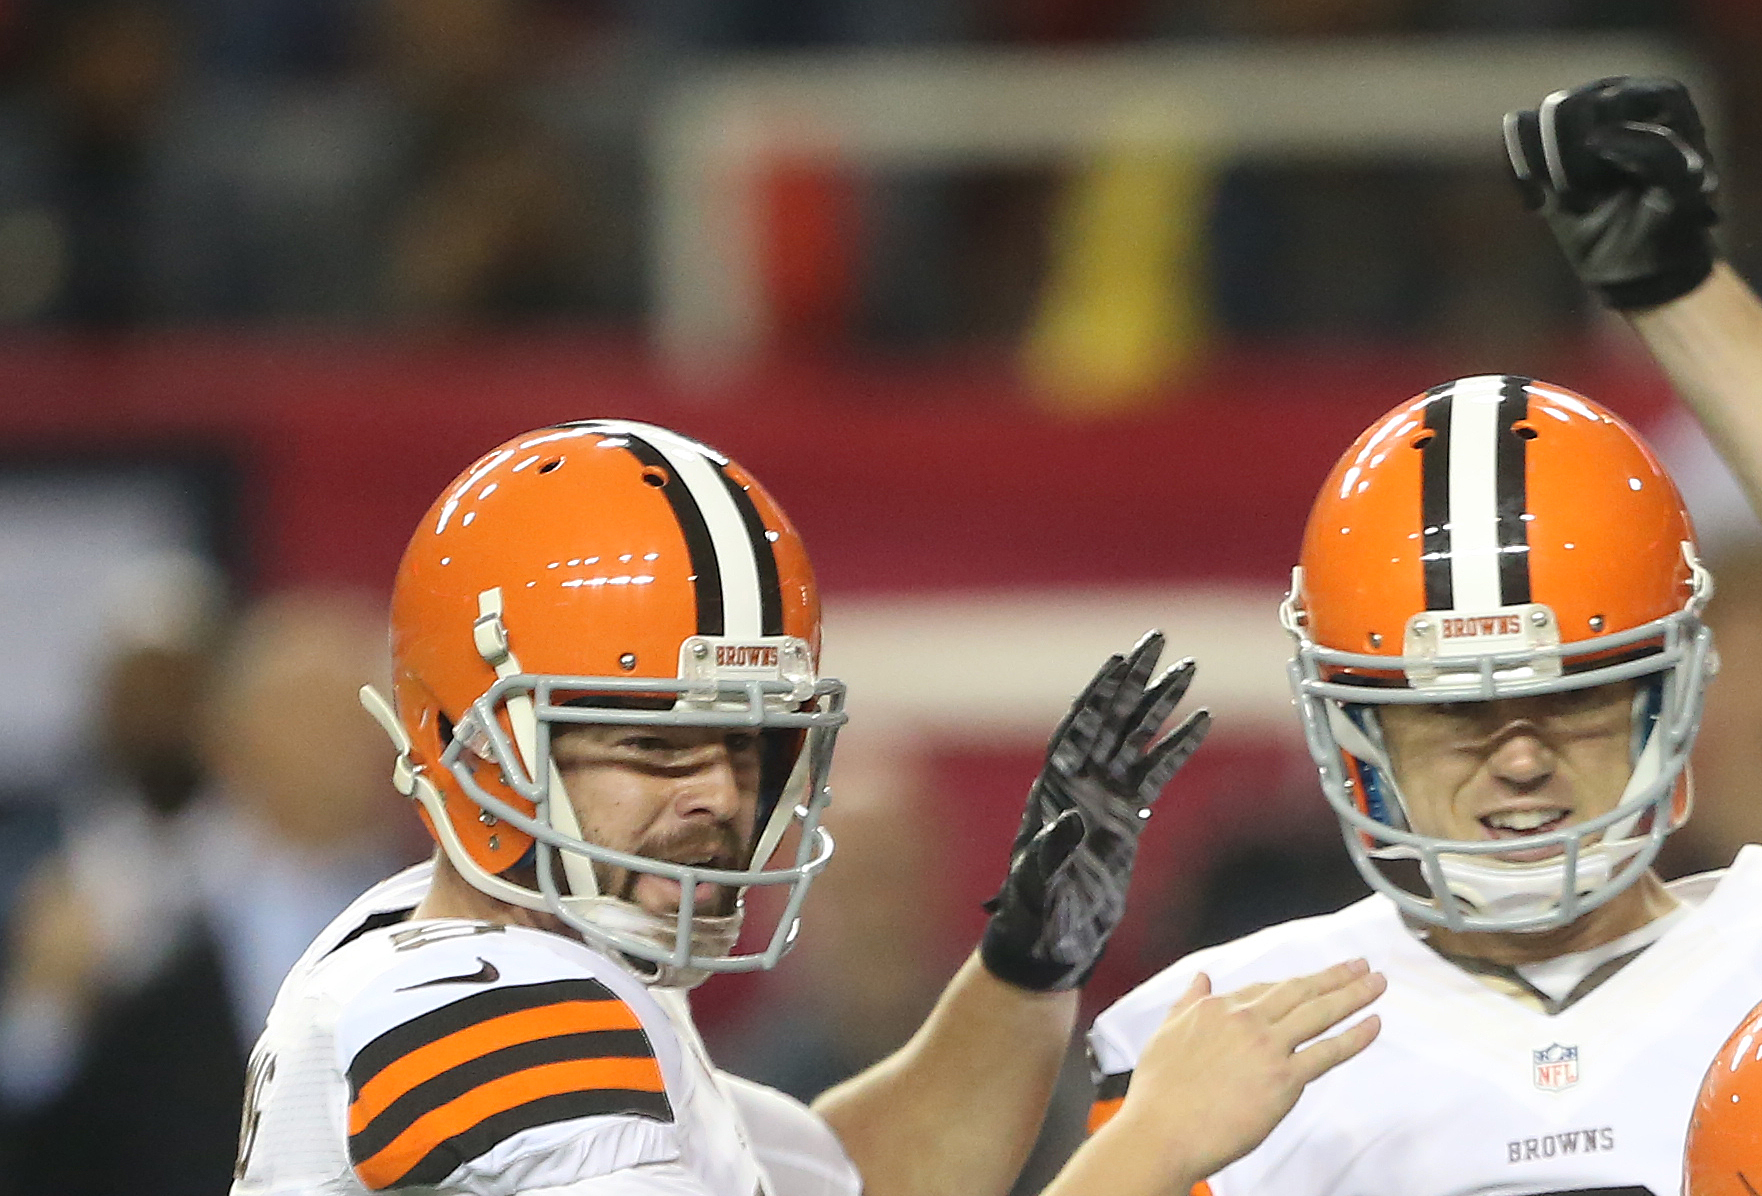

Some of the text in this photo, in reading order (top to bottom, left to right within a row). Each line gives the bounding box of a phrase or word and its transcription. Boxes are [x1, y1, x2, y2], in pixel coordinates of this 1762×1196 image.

[1442, 614, 1520, 638] BROWNS
[715, 646, 778, 667] BROWNS
[1536, 1061, 1579, 1087] NFL
[1506, 1126, 1614, 1163] BROWNS
